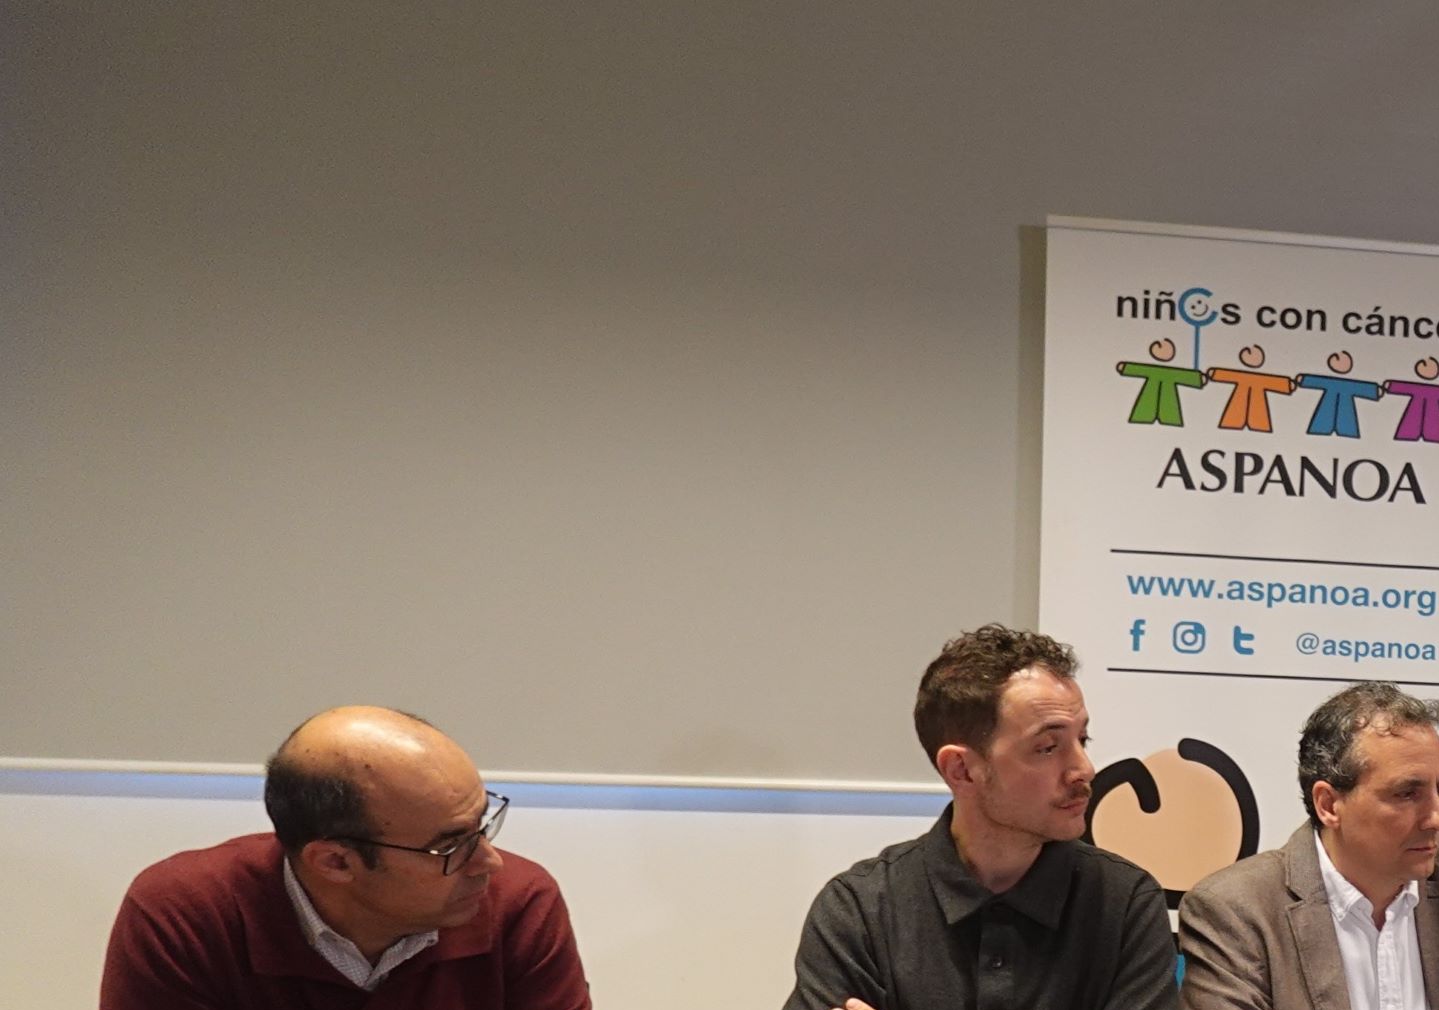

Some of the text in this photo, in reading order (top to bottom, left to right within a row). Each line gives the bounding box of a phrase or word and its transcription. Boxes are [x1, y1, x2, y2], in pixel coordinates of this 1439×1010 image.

[1256, 305, 1327, 331] con
[1156, 447, 1427, 505] ASPANOA
[1127, 574, 1437, 616] www.aspanoa.org
[1295, 632, 1436, 662] @aspanoa
